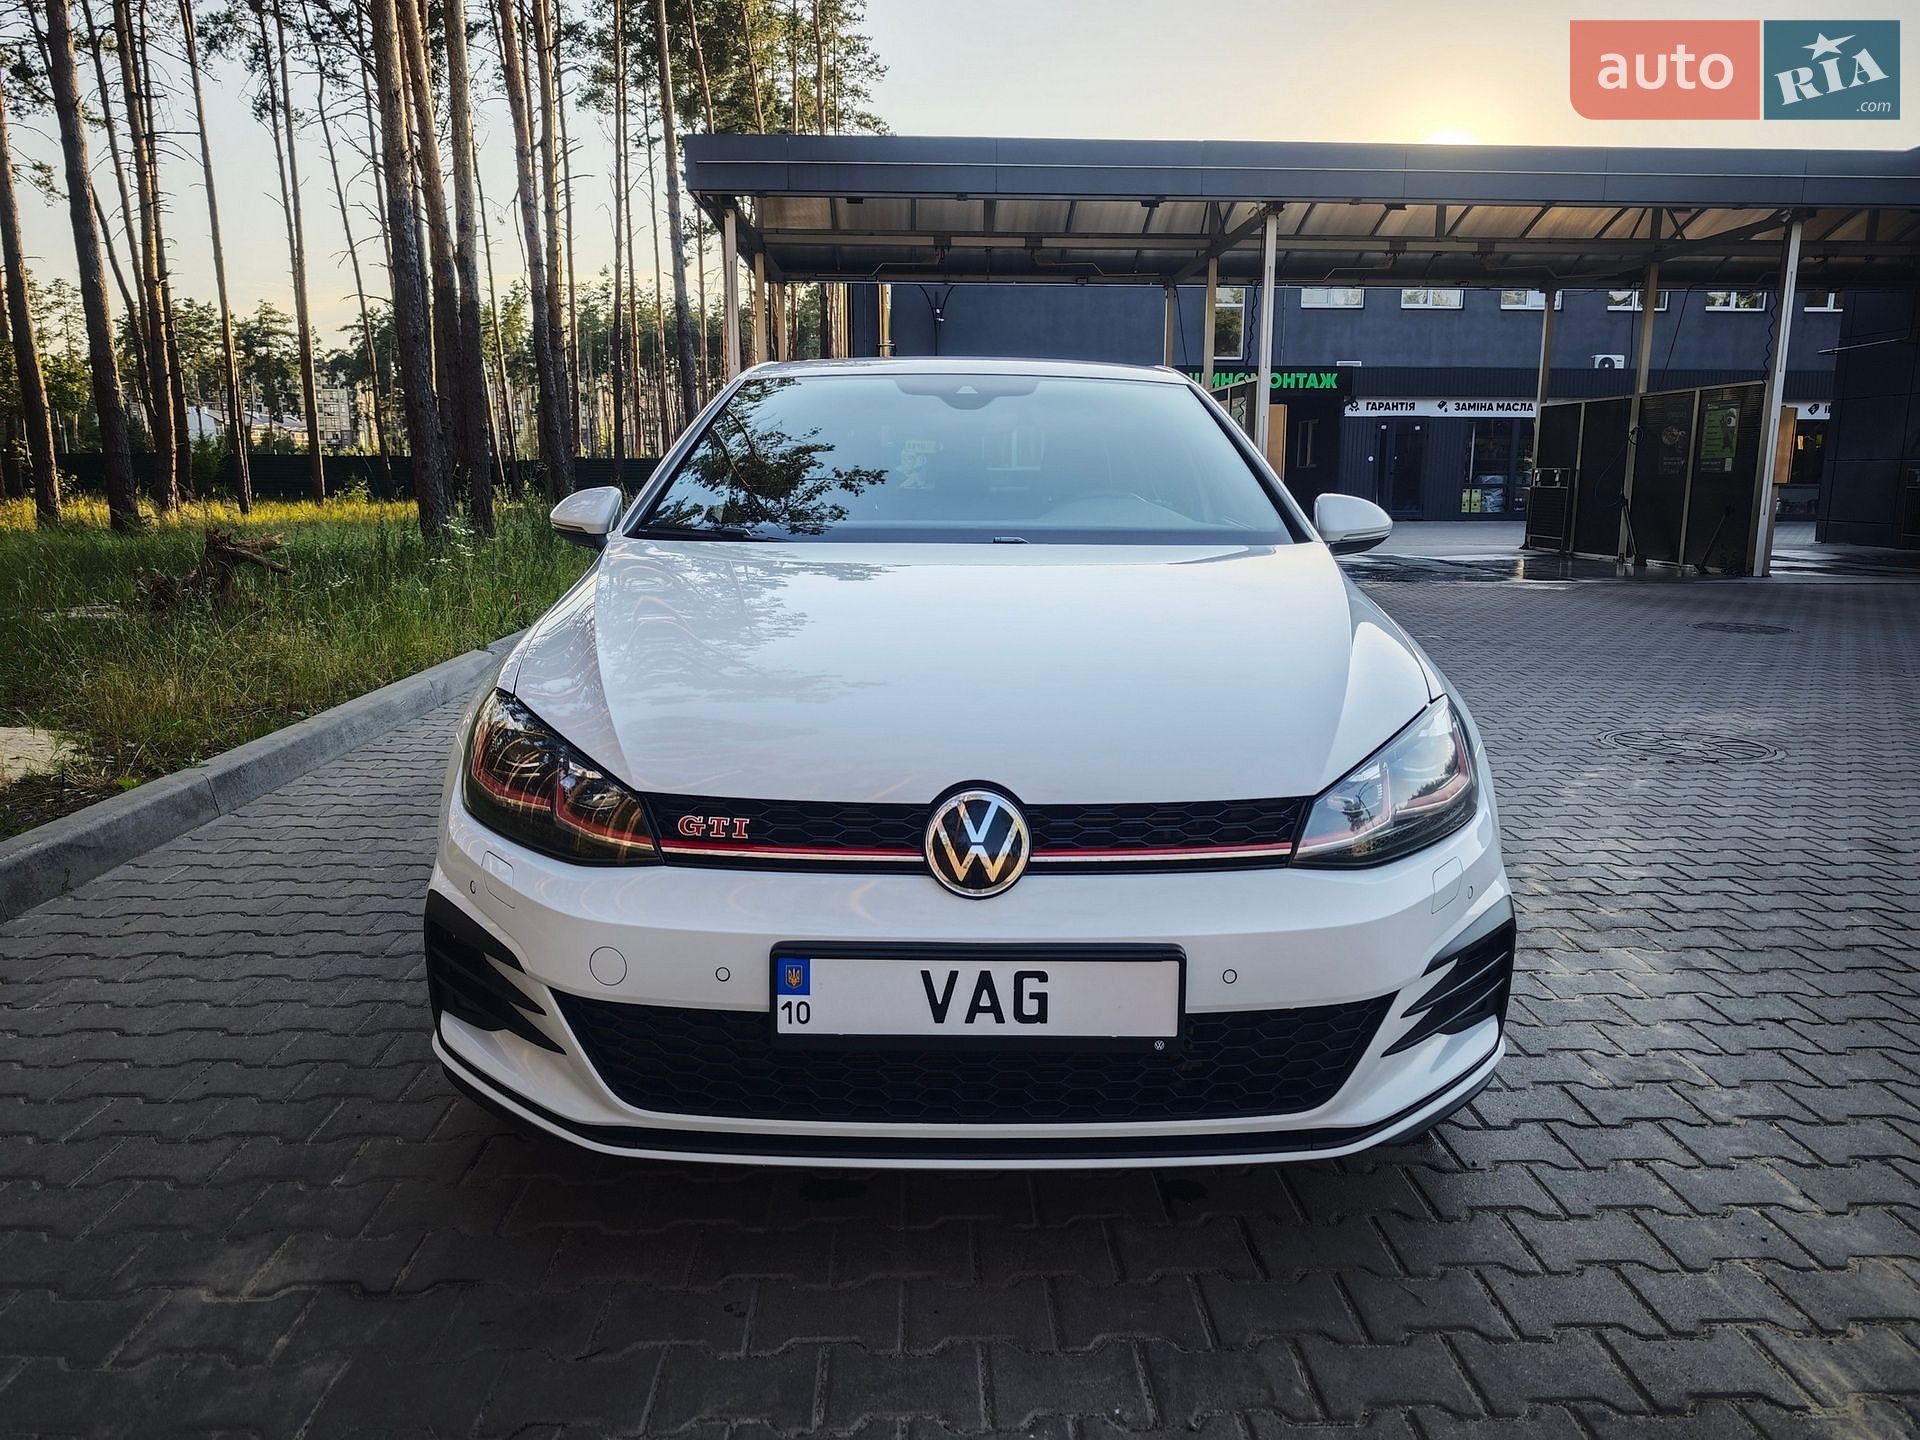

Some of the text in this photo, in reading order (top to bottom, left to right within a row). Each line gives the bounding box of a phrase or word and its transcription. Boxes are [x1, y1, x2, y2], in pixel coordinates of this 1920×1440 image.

[1365, 401, 1416, 412] ГАРАНТІЯ
[1454, 402, 1534, 413] ЗАМІНА МАСЛА
[677, 815, 749, 839] GTI
[920, 970, 1049, 1025] VAG
[780, 1000, 811, 1025] 10
